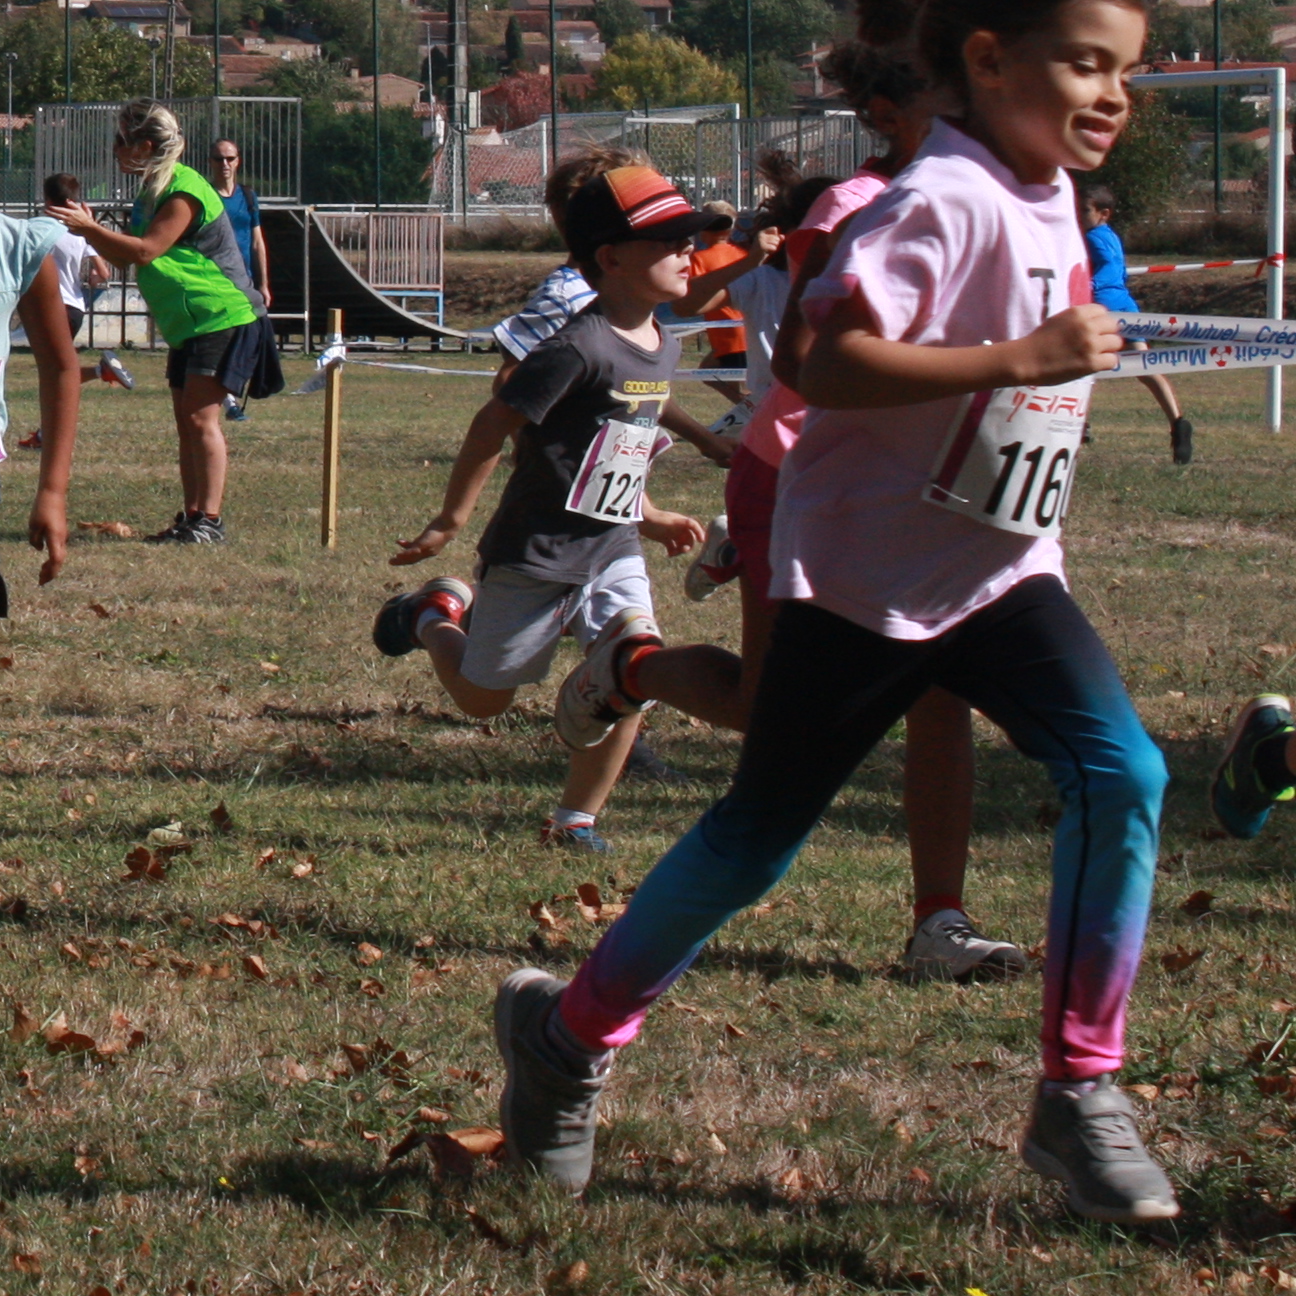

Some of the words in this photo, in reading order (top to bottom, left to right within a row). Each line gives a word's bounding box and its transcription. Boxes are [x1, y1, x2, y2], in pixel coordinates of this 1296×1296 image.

[1117, 318, 1161, 338] Crédit
[1178, 321, 1240, 341] Mutuel
[1143, 348, 1207, 370] Mutuel
[624, 380, 649, 393] GOOD
[983, 441, 1076, 529] 116
